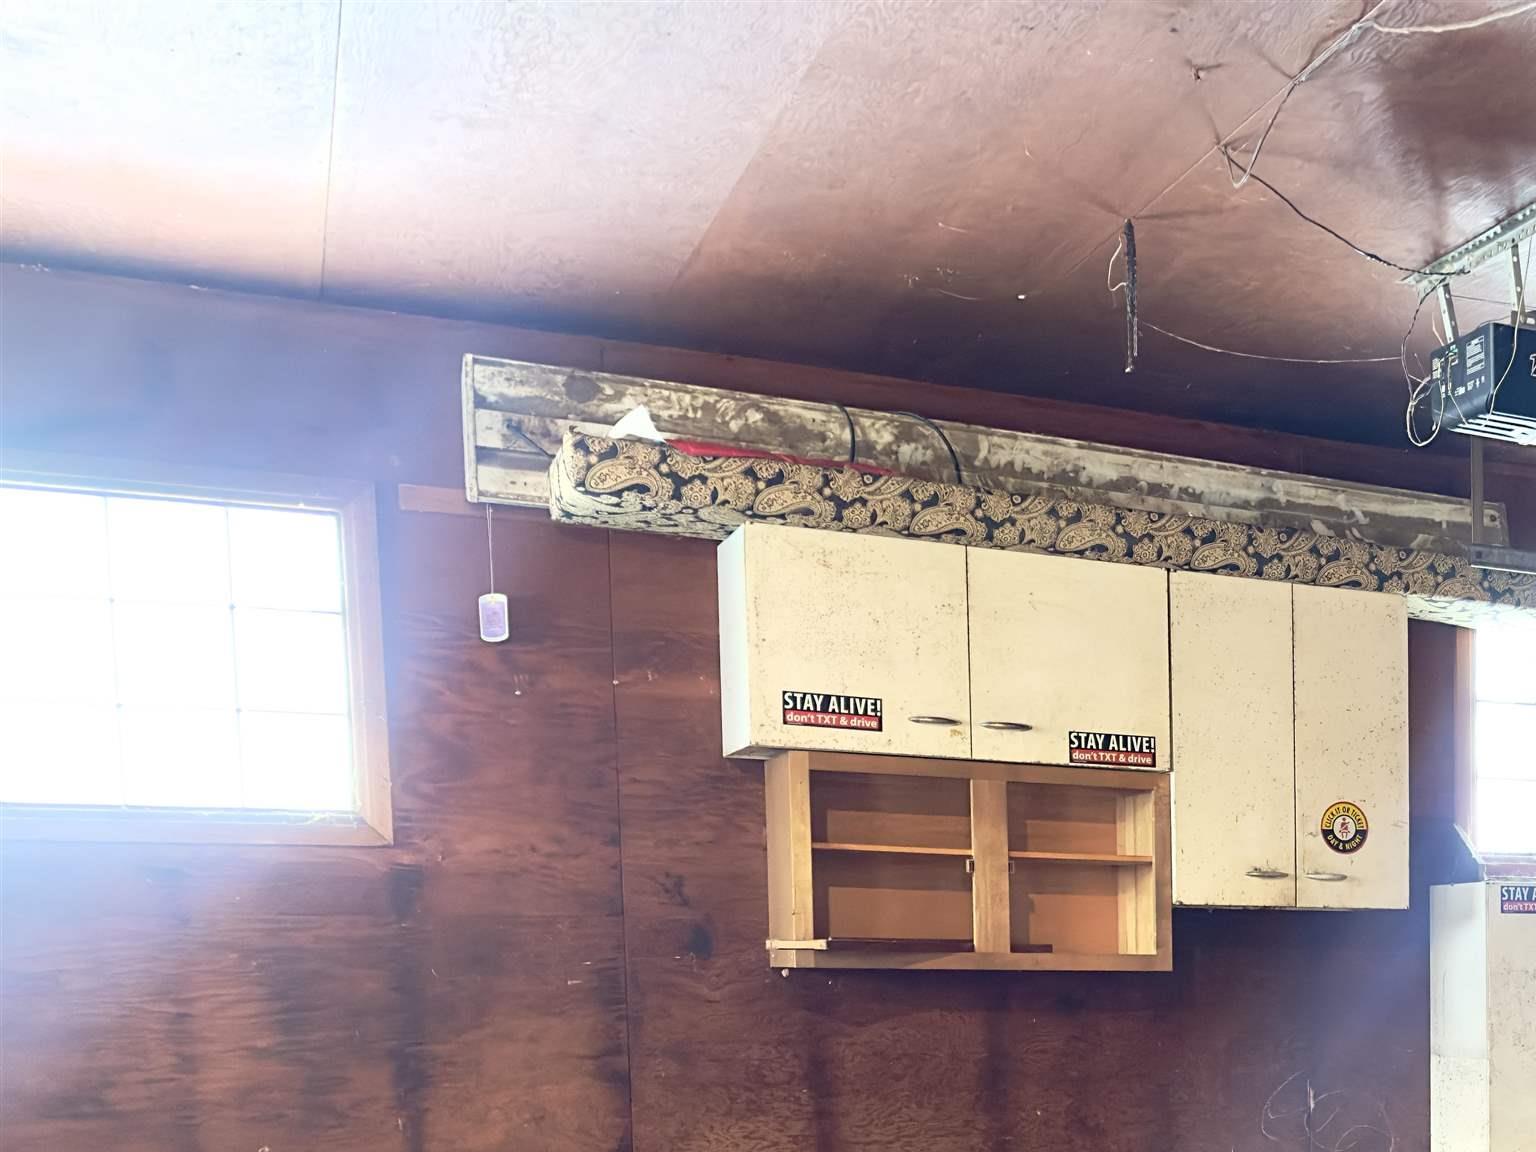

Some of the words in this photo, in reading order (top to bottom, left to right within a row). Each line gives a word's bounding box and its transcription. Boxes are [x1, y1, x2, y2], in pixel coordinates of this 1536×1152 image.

[784, 692, 824, 712] STAY
[828, 696, 881, 716] ALIVE!
[786, 712, 815, 723] don't
[816, 714, 838, 725] TXT
[839, 716, 849, 726] &
[850, 717, 879, 728] drive
[1070, 732, 1105, 749] STAY
[1109, 735, 1155, 753] ALIVE!
[1072, 750, 1098, 760] don't
[1098, 752, 1117, 762] TXT
[1118, 754, 1127, 762] &
[1127, 754, 1152, 764] drive
[1502, 886, 1530, 900] STAY
